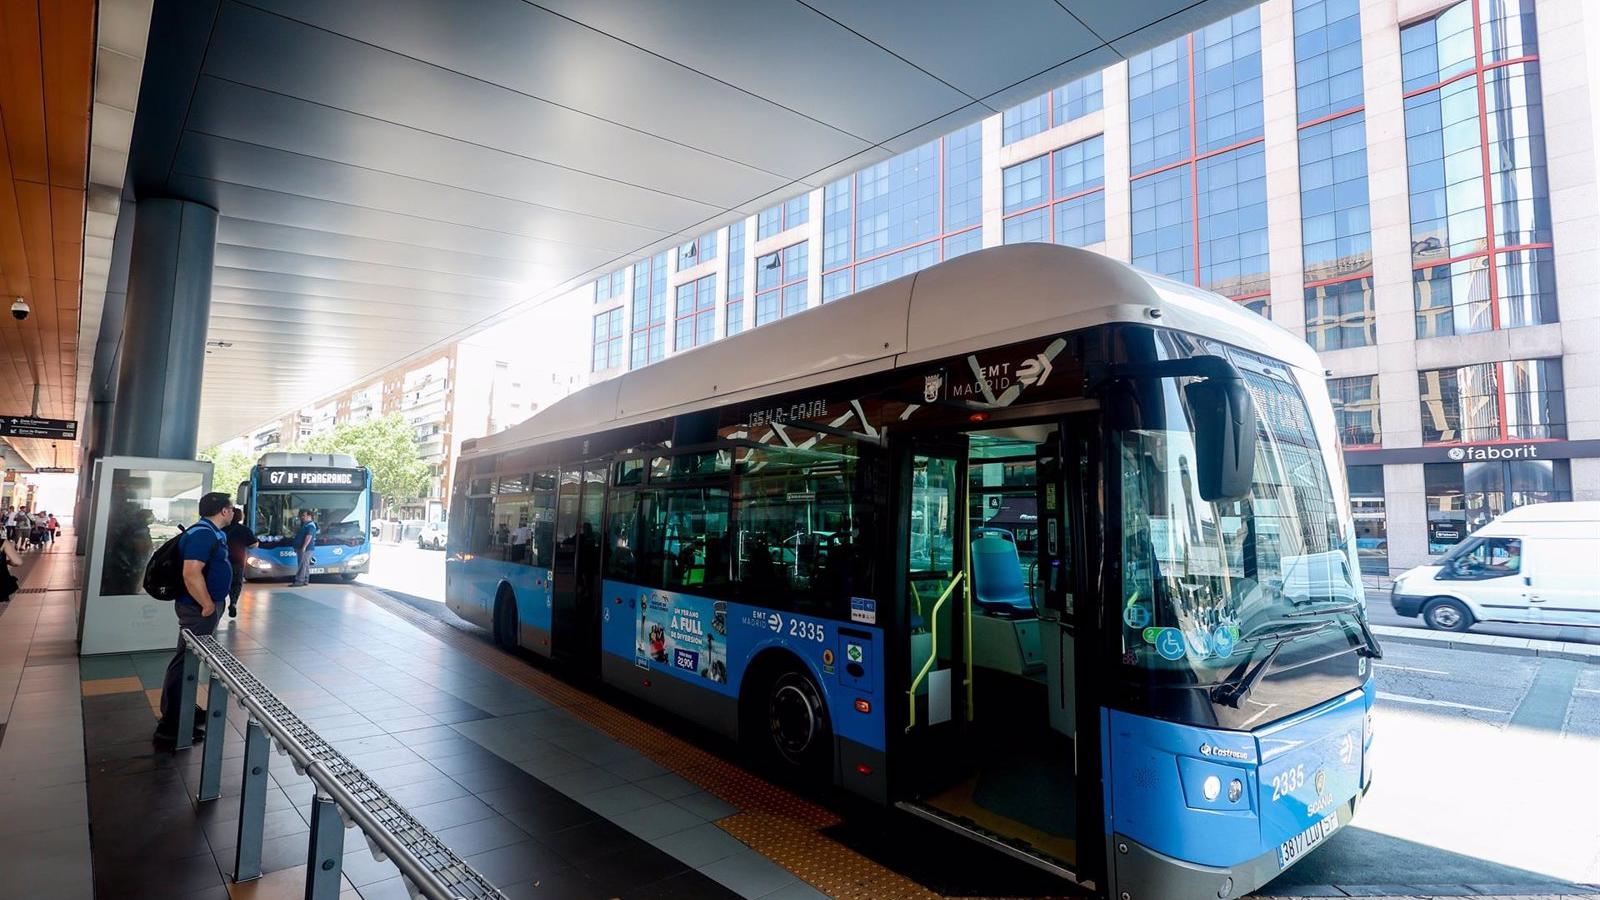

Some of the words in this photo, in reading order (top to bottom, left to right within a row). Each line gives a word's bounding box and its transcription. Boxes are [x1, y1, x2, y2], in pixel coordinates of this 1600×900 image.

[979, 362, 1010, 379] EMT
[953, 377, 1010, 397] MADRID
[1466, 445, 1537, 460] faborit
[270, 471, 285, 484] 67
[670, 615, 679, 629] A
[680, 617, 703, 635] FULL
[742, 616, 766, 629] MADRID
[752, 610, 767, 620] EMT
[789, 618, 825, 643] 2335
[1272, 764, 1304, 801] 2335
[1306, 793, 1334, 817] SCANIA
[1283, 832, 1303, 861] 3817
